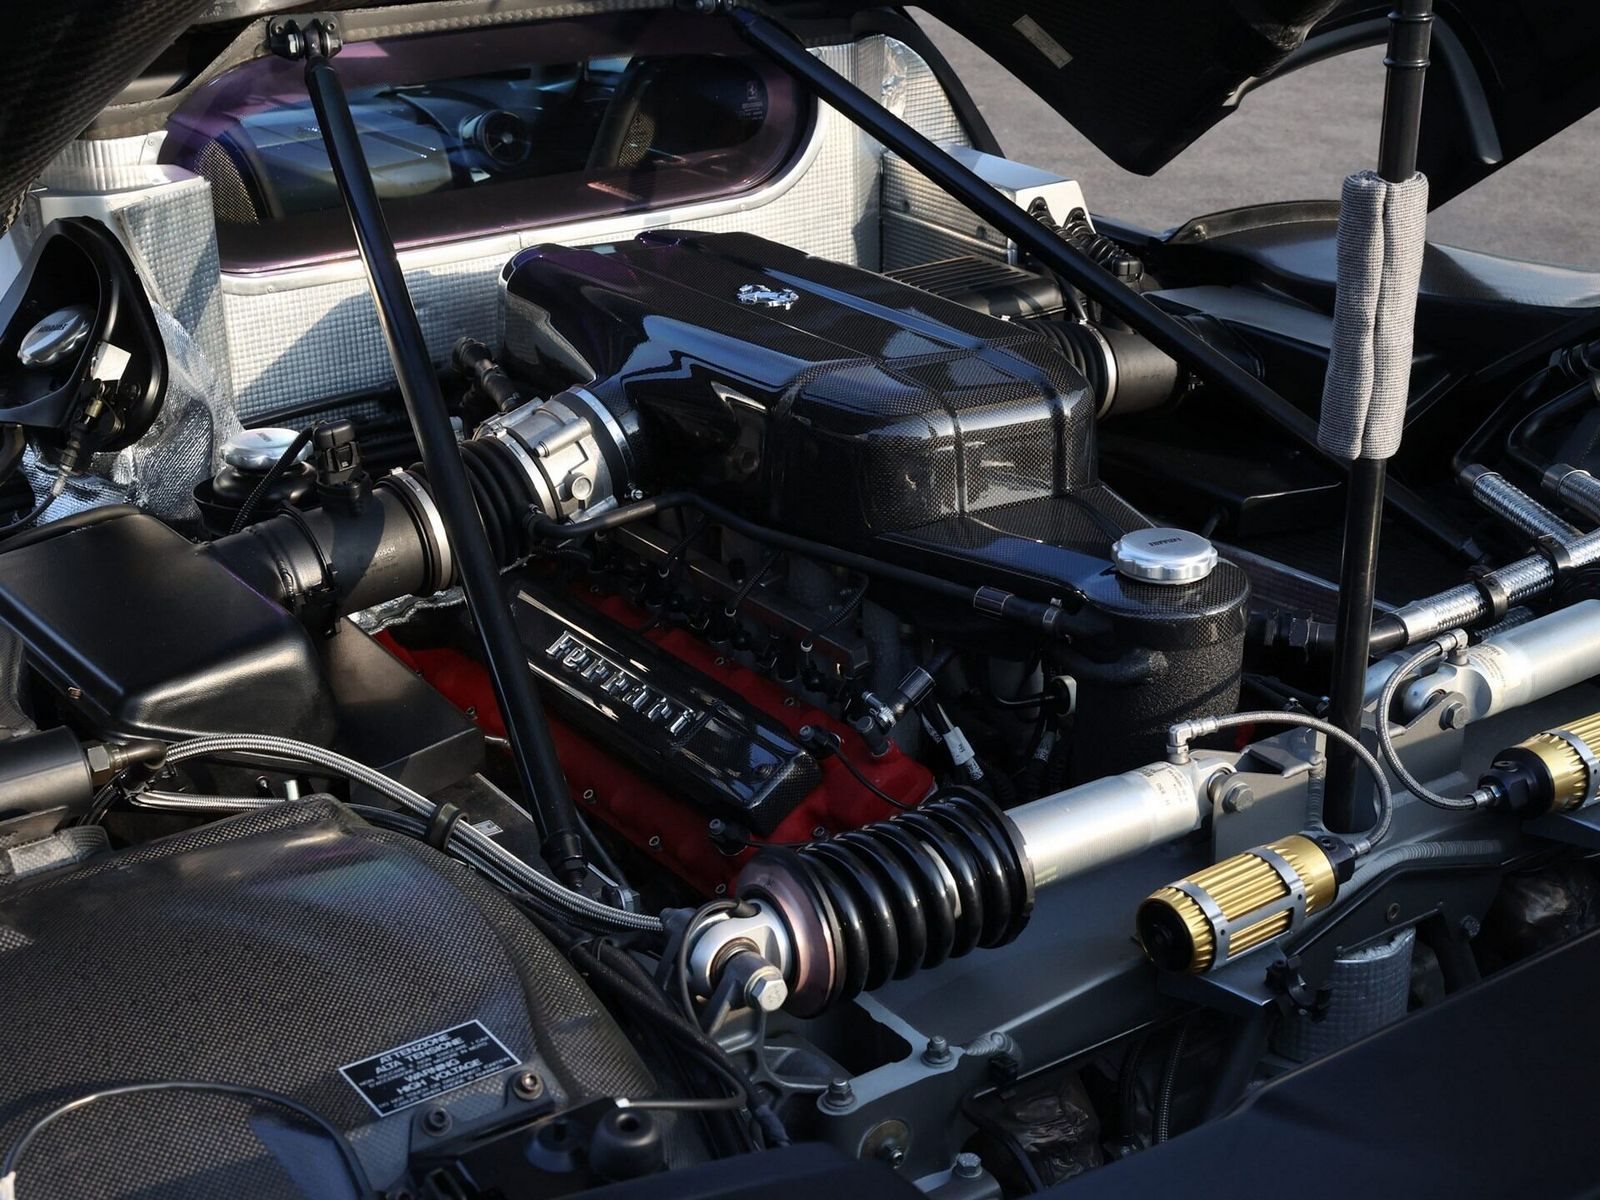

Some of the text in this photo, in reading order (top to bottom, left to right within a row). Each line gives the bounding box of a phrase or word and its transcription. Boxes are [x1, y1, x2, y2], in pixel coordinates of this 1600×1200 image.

[545, 630, 695, 736] Ferrari
[375, 1060, 403, 1074] ALTA
[405, 1037, 465, 1062] TENSIONE
[379, 1034, 451, 1064] ATTENZIONE
[396, 1079, 427, 1094] HIGH
[430, 1058, 483, 1082] VOLTAGE
[403, 1058, 460, 1082] WARNING
